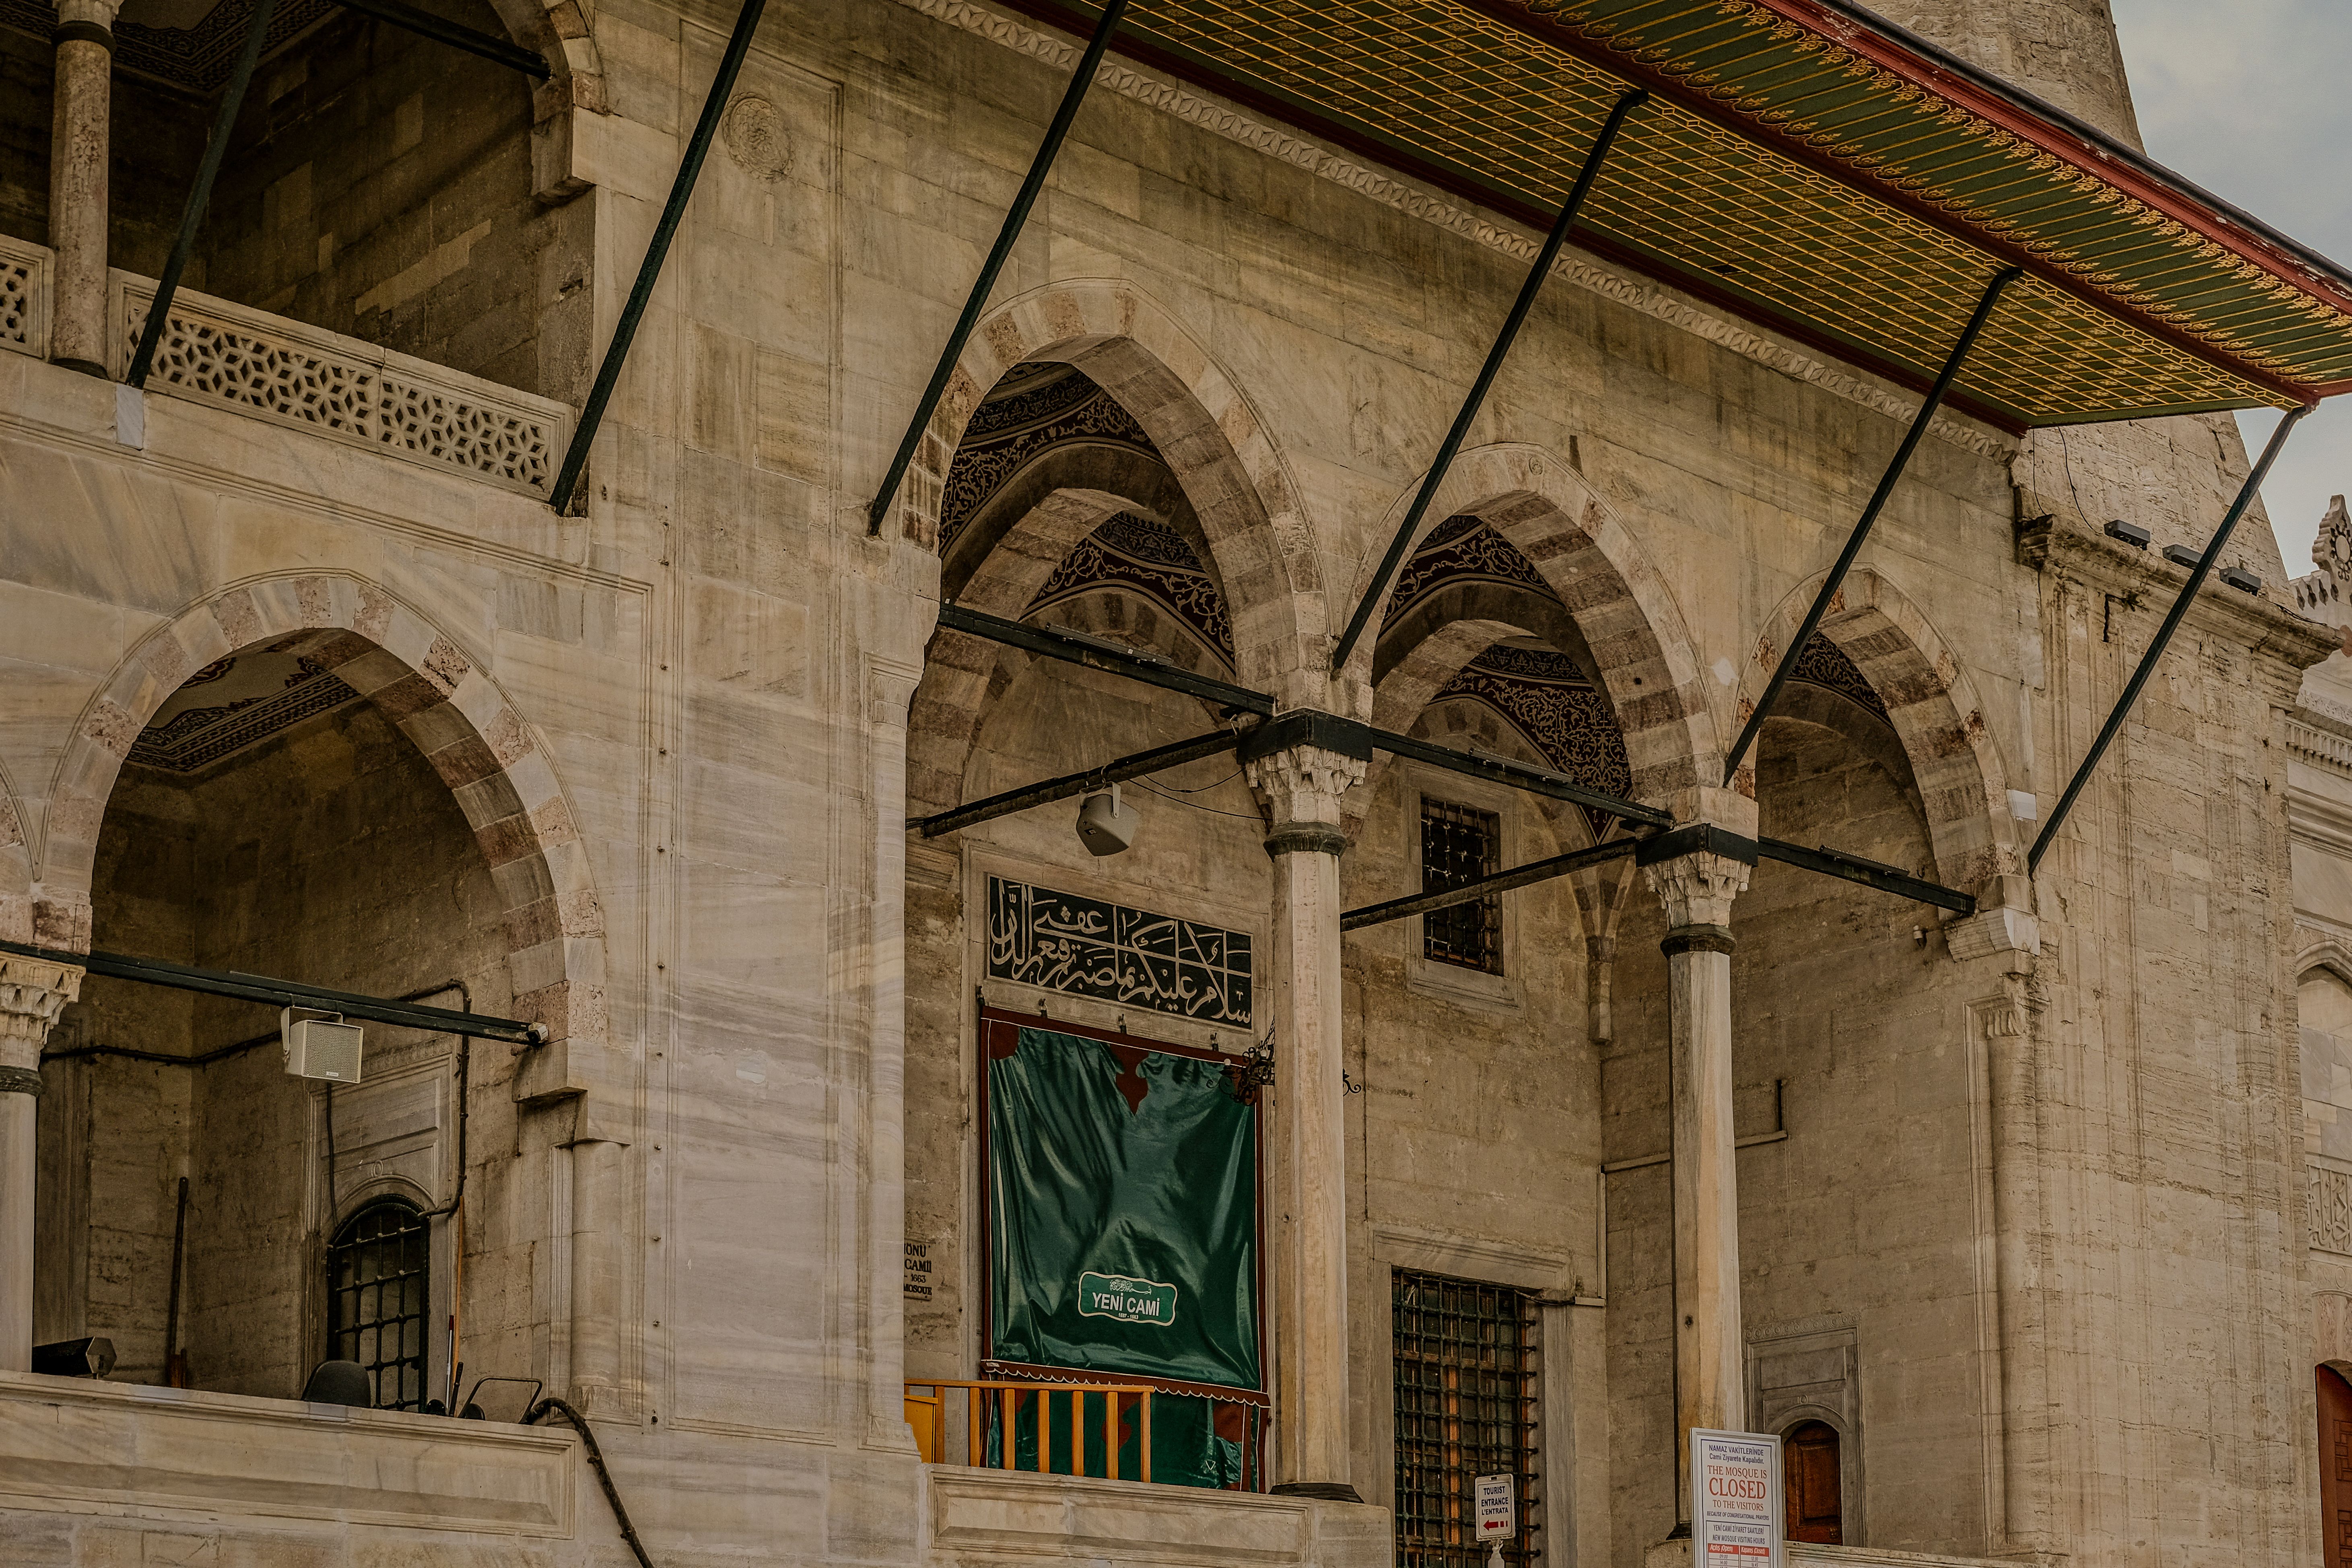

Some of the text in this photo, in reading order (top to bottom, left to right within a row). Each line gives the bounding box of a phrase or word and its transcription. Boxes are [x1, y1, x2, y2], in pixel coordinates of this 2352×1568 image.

[911, 1273, 926, 1283] 1663
[1093, 1292, 1160, 1316] YENİ CAMİ
[1709, 1444, 1764, 1456] NAMAZ VAKİTLERİNDE
[1723, 1454, 1741, 1462] Ziyarete
[1742, 1456, 1764, 1464] Kapalıdır.
[1707, 1465, 1767, 1479] THE MOSQUE IS
[1483, 1486, 1505, 1495] TOURIST
[1709, 1477, 1766, 1499] CLOSED
[1481, 1497, 1509, 1507] ENTRANCE
[1713, 1500, 1764, 1511] TO THE VISITORS
[1482, 1507, 1509, 1515] L'ENTRATA
[1732, 1524, 1746, 1533] ZİYARET
